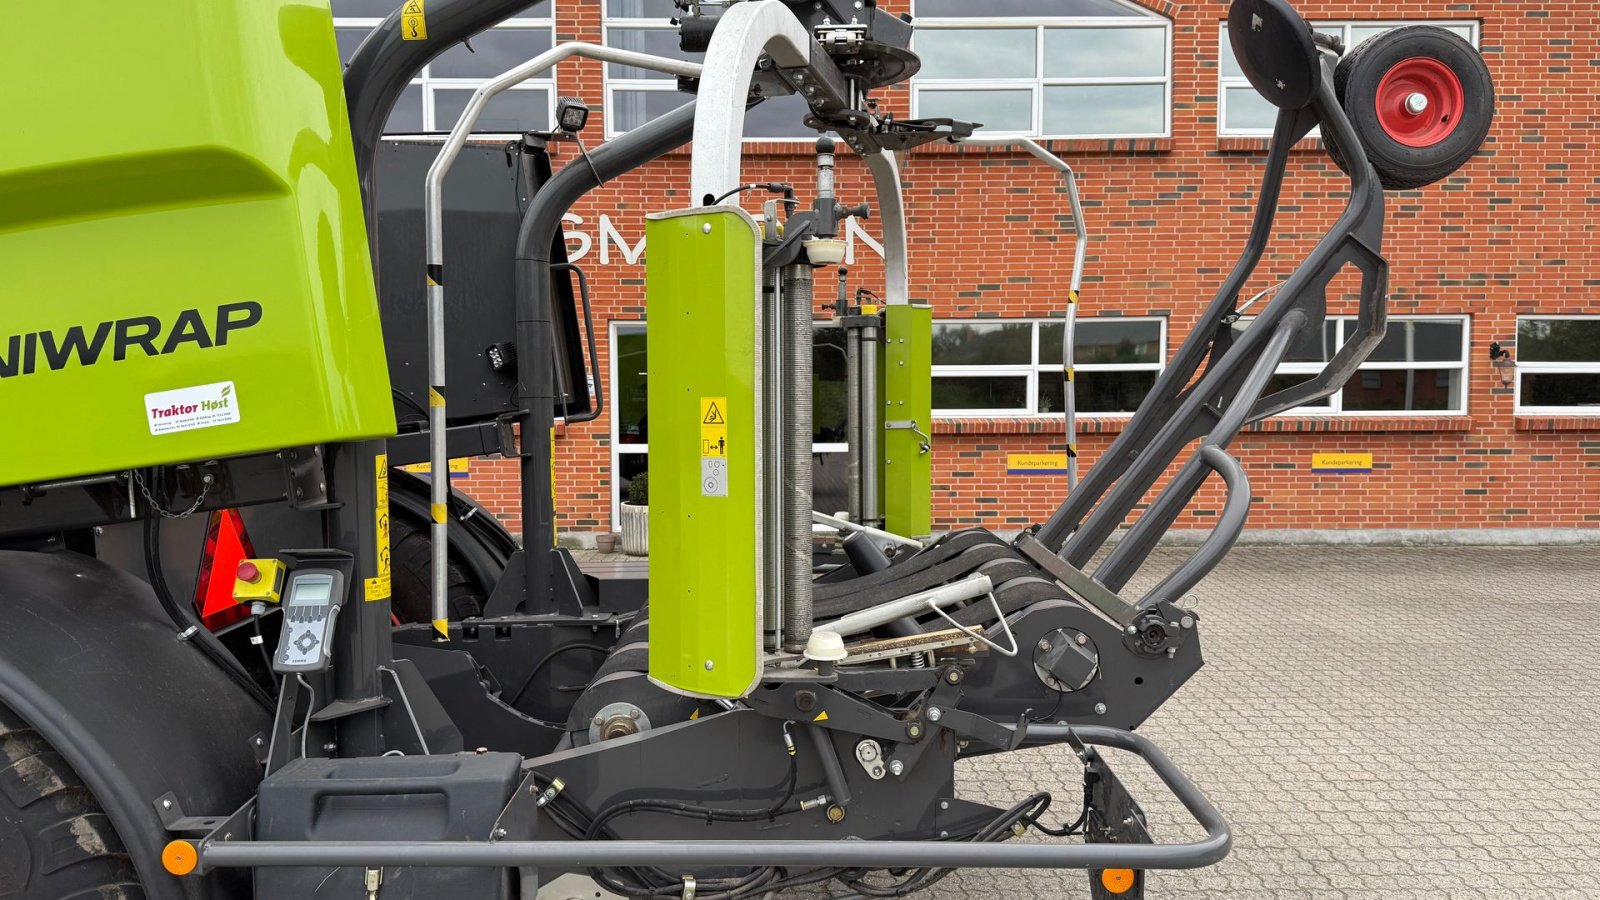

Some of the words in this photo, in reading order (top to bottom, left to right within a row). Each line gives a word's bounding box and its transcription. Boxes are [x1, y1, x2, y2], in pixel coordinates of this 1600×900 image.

[152, 404, 199, 419] Traktor
[201, 398, 229, 411] Høst
[1017, 459, 1058, 468] Kundeparkering
[1321, 459, 1363, 467] Kundeparkering
